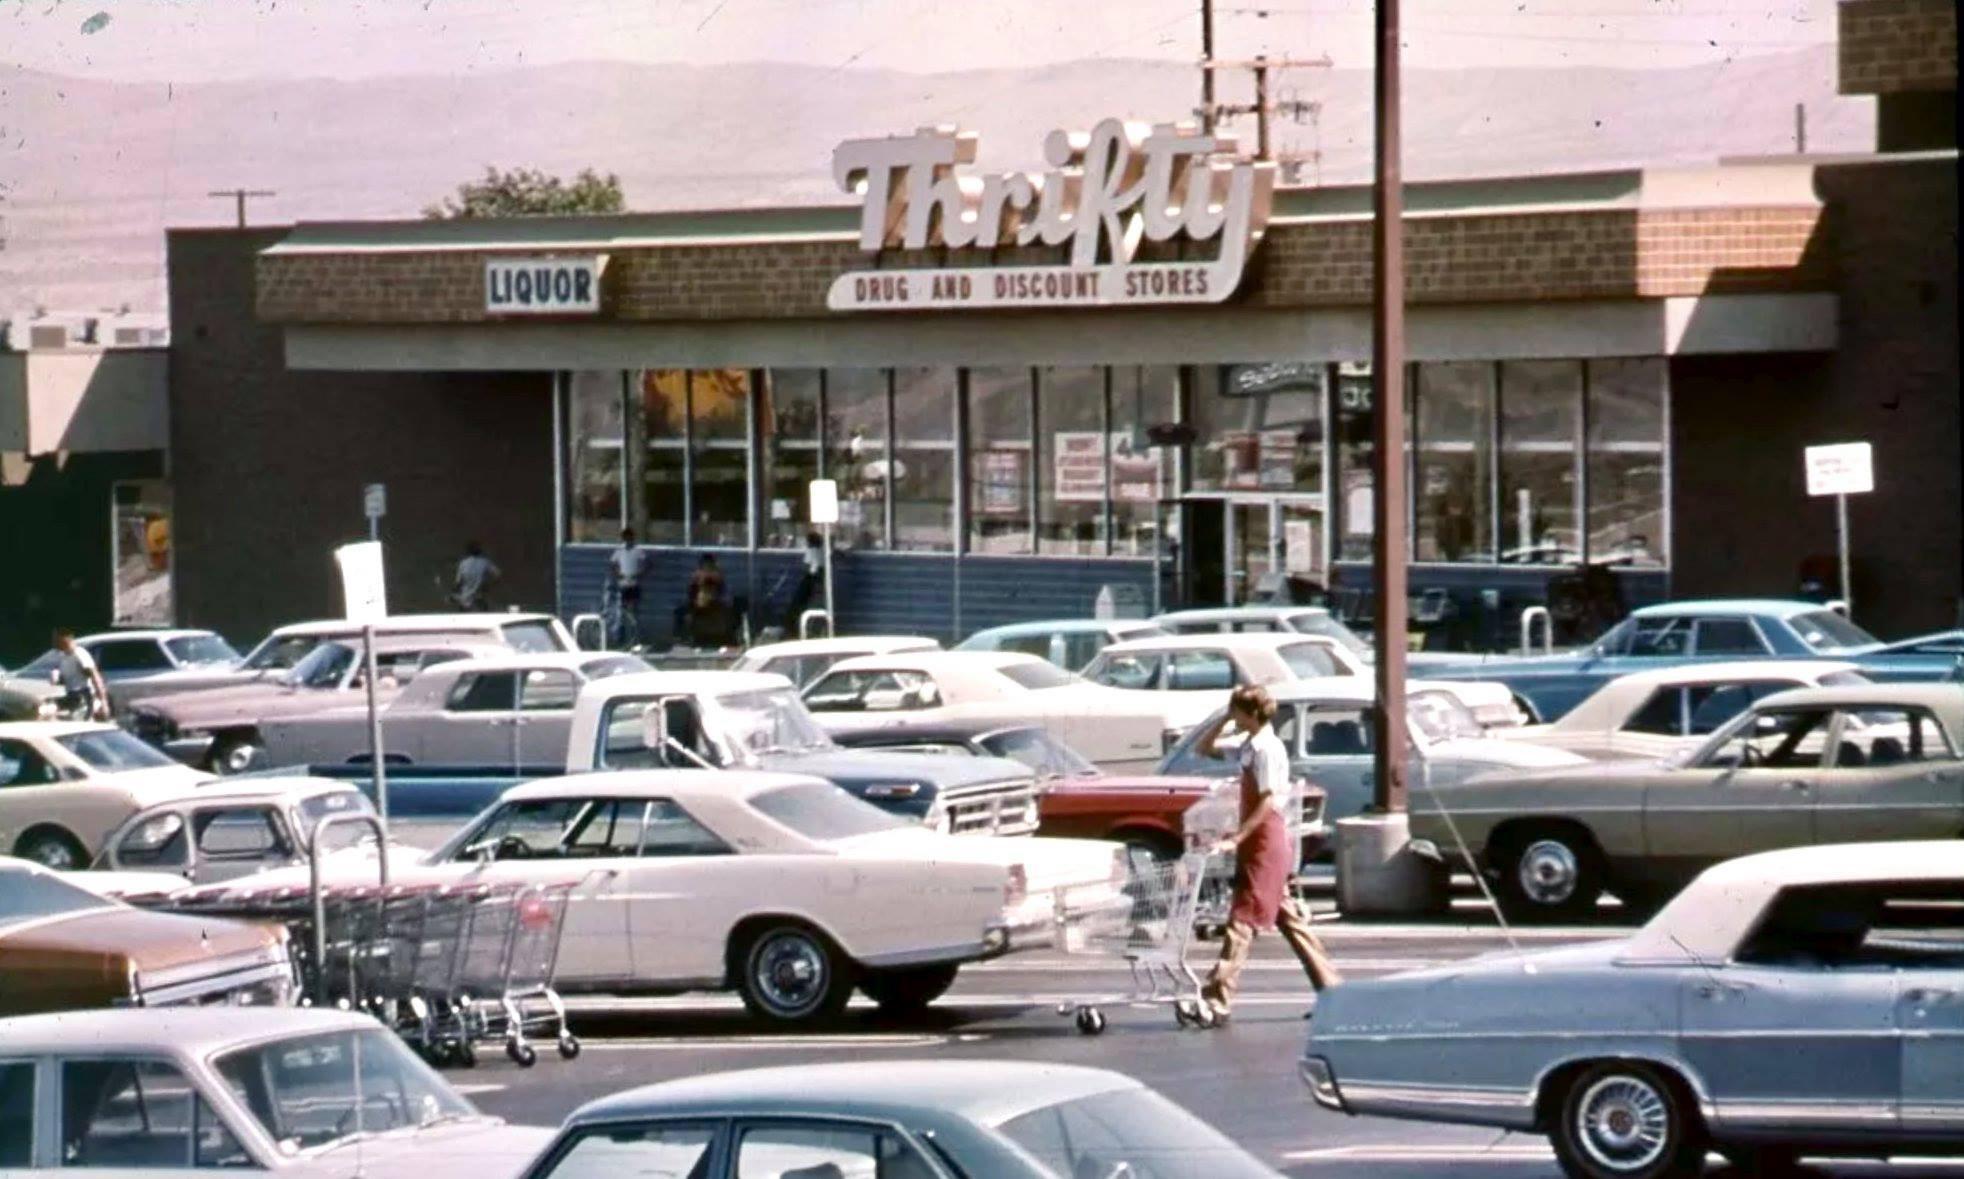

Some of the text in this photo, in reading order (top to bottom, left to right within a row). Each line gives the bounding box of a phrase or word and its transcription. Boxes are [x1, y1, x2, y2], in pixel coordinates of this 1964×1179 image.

[832, 117, 1257, 268] Thrifty
[491, 267, 592, 304] LIQUOR
[855, 268, 1209, 301] DRUG AND DISCOUNT STORES
